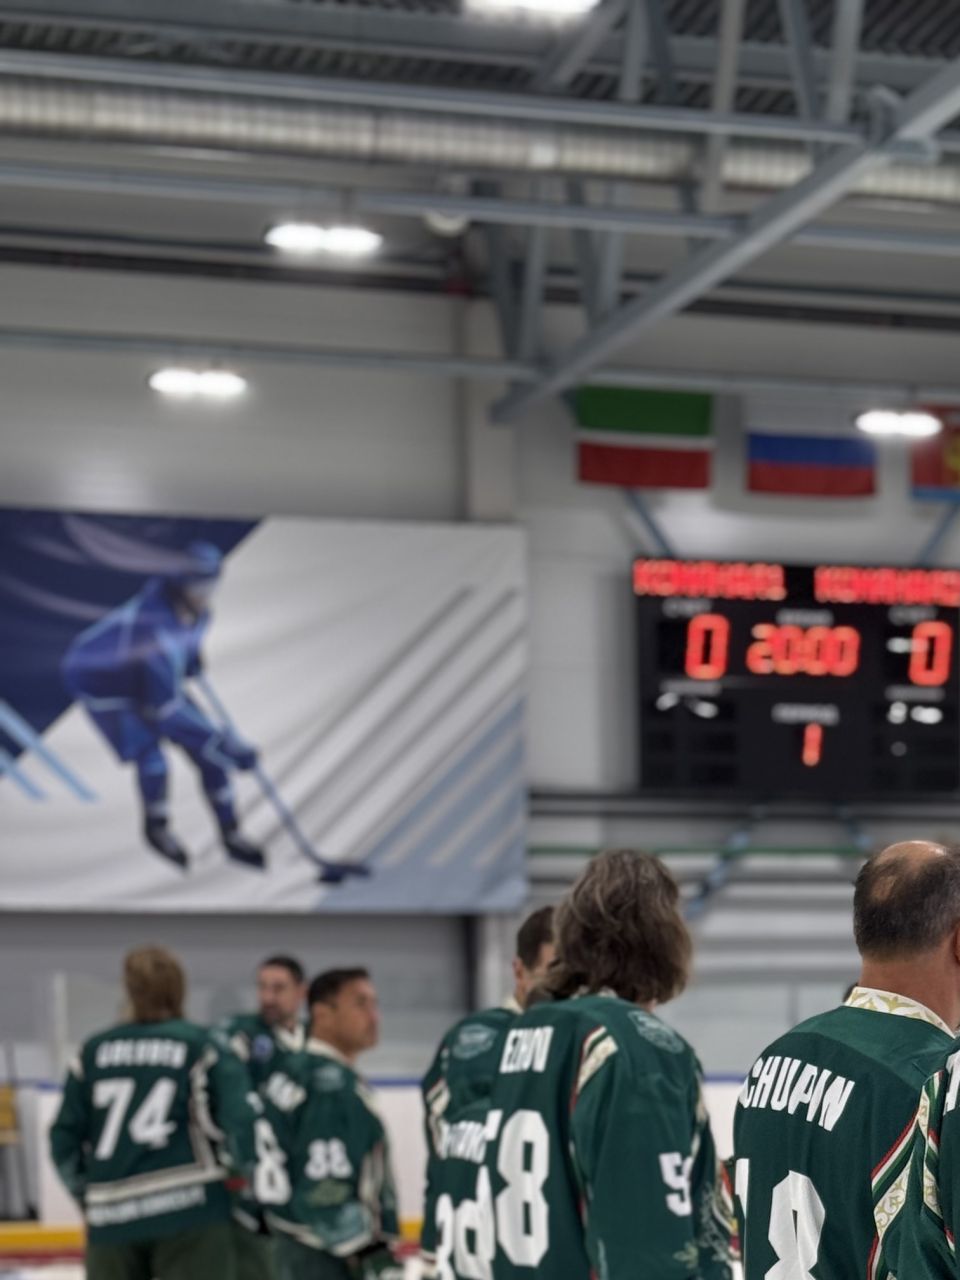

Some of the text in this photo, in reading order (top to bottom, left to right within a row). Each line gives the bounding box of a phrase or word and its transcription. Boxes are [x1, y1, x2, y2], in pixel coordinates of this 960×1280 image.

[685, 613, 730, 680] 0
[908, 620, 953, 686] 0
[93, 1076, 177, 1161] 74
[739, 1055, 856, 1132] CHUPIN
